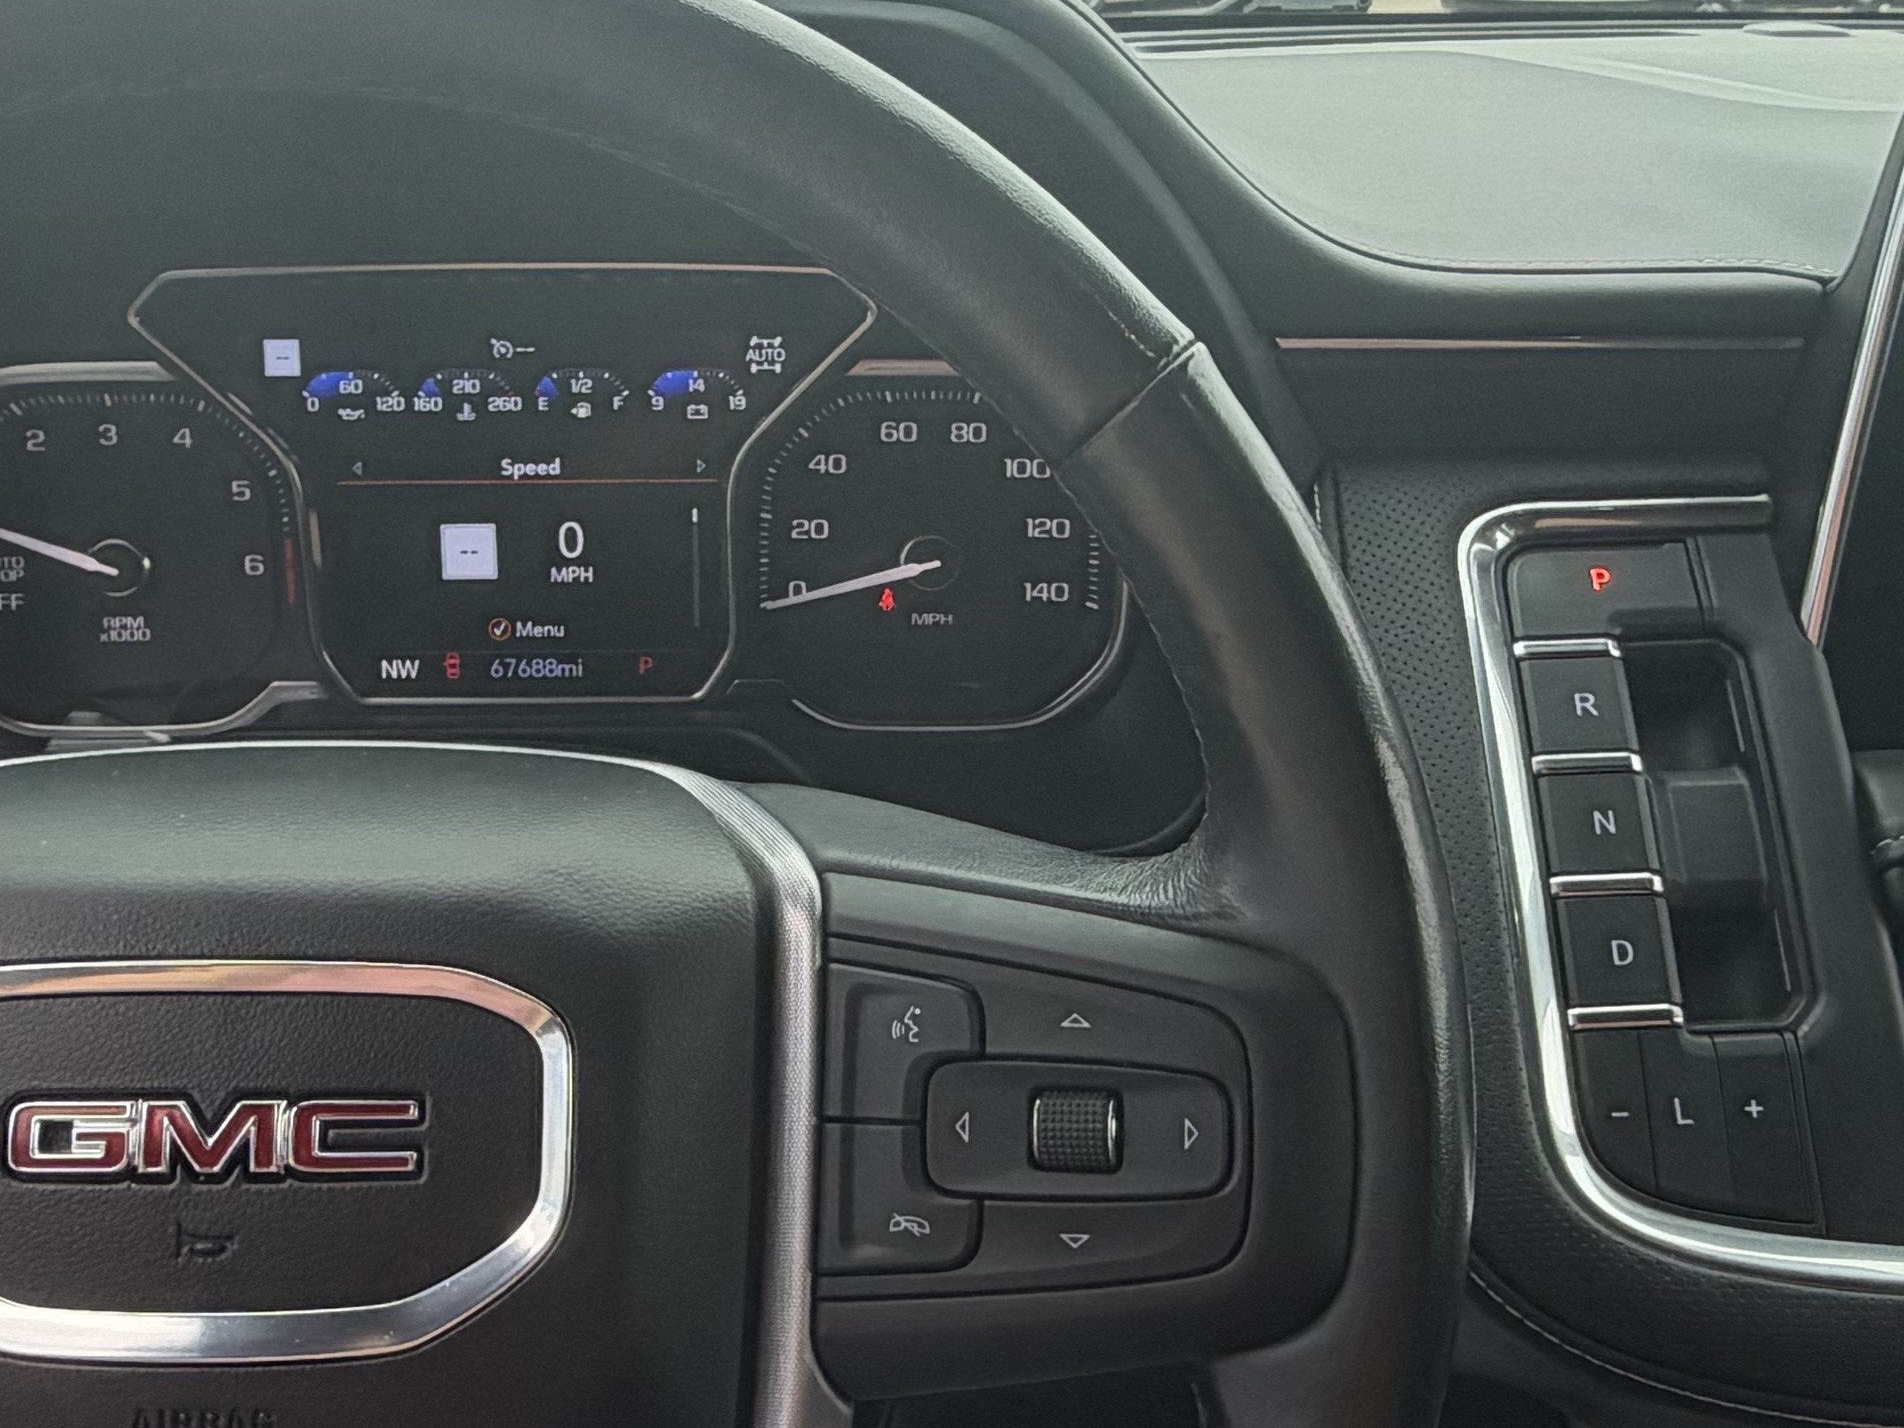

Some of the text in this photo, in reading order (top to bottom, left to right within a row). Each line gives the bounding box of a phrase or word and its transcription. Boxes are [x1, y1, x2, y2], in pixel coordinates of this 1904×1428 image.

[745, 347, 786, 363] AUTO
[338, 378, 363, 395] 60
[452, 378, 481, 395] 210
[570, 378, 593, 395] 1/2
[687, 378, 706, 395] 14
[306, 396, 320, 412] 0
[375, 396, 406, 412] 120
[413, 396, 443, 412] 160
[487, 396, 523, 412] 260
[538, 396, 550, 412] E
[612, 396, 625, 412] F
[651, 396, 664, 412] 9
[728, 396, 747, 412] 19
[25, 429, 46, 452] 2
[98, 423, 118, 446] 3
[172, 427, 193, 448] 4
[879, 422, 919, 443] 60
[949, 422, 988, 443] 80
[500, 459, 561, 480] Speed
[808, 453, 847, 474] 40
[1004, 457, 1052, 479] 100
[231, 480, 251, 502] 5
[791, 518, 830, 539] 20
[1025, 517, 1071, 539] 120
[557, 520, 585, 559] 0
[243, 554, 265, 576] 6
[550, 567, 594, 584] MPH
[1588, 566, 1612, 591] P
[1023, 582, 1070, 604] 140
[102, 616, 145, 630] RPM
[911, 612, 954, 626] MPH
[515, 622, 566, 639] Menu
[380, 660, 420, 680] NW
[489, 657, 584, 679] 67688mi
[639, 656, 654, 674] P
[1573, 692, 1600, 717] R
[1593, 810, 1618, 836] N
[1610, 938, 1634, 967] D
[1674, 1097, 1695, 1126] L
[6, 1098, 421, 1173] GMC
